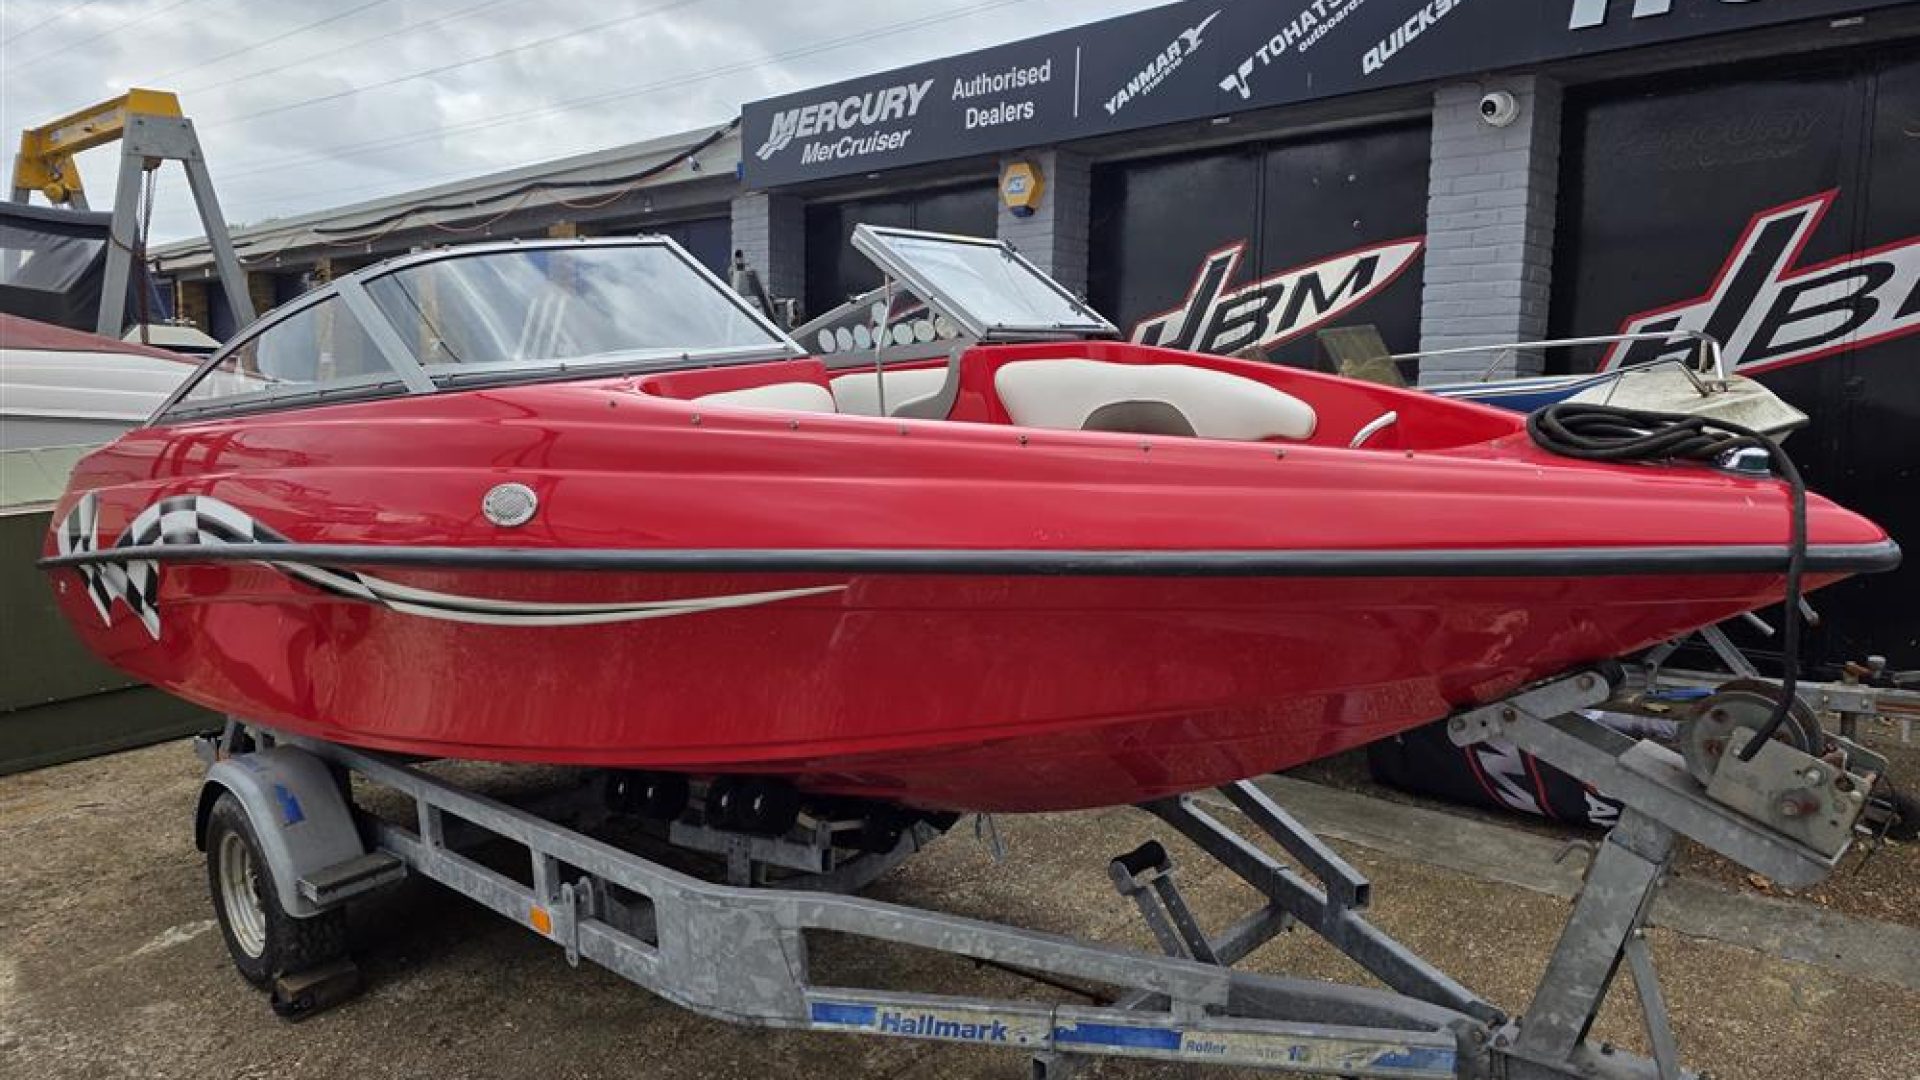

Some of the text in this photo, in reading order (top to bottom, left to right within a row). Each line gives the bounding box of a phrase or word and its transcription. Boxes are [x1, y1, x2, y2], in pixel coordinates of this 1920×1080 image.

[1363, 0, 1460, 75] QUICKS
[952, 58, 1051, 101] Authorised
[1104, 40, 1181, 115] YANMAR
[767, 79, 935, 146] MERCURY
[966, 101, 1034, 130] Dealers
[801, 129, 912, 165] MerCruiser
[1141, 254, 1380, 354] JBM
[880, 1012, 1007, 1041] Hallmark
